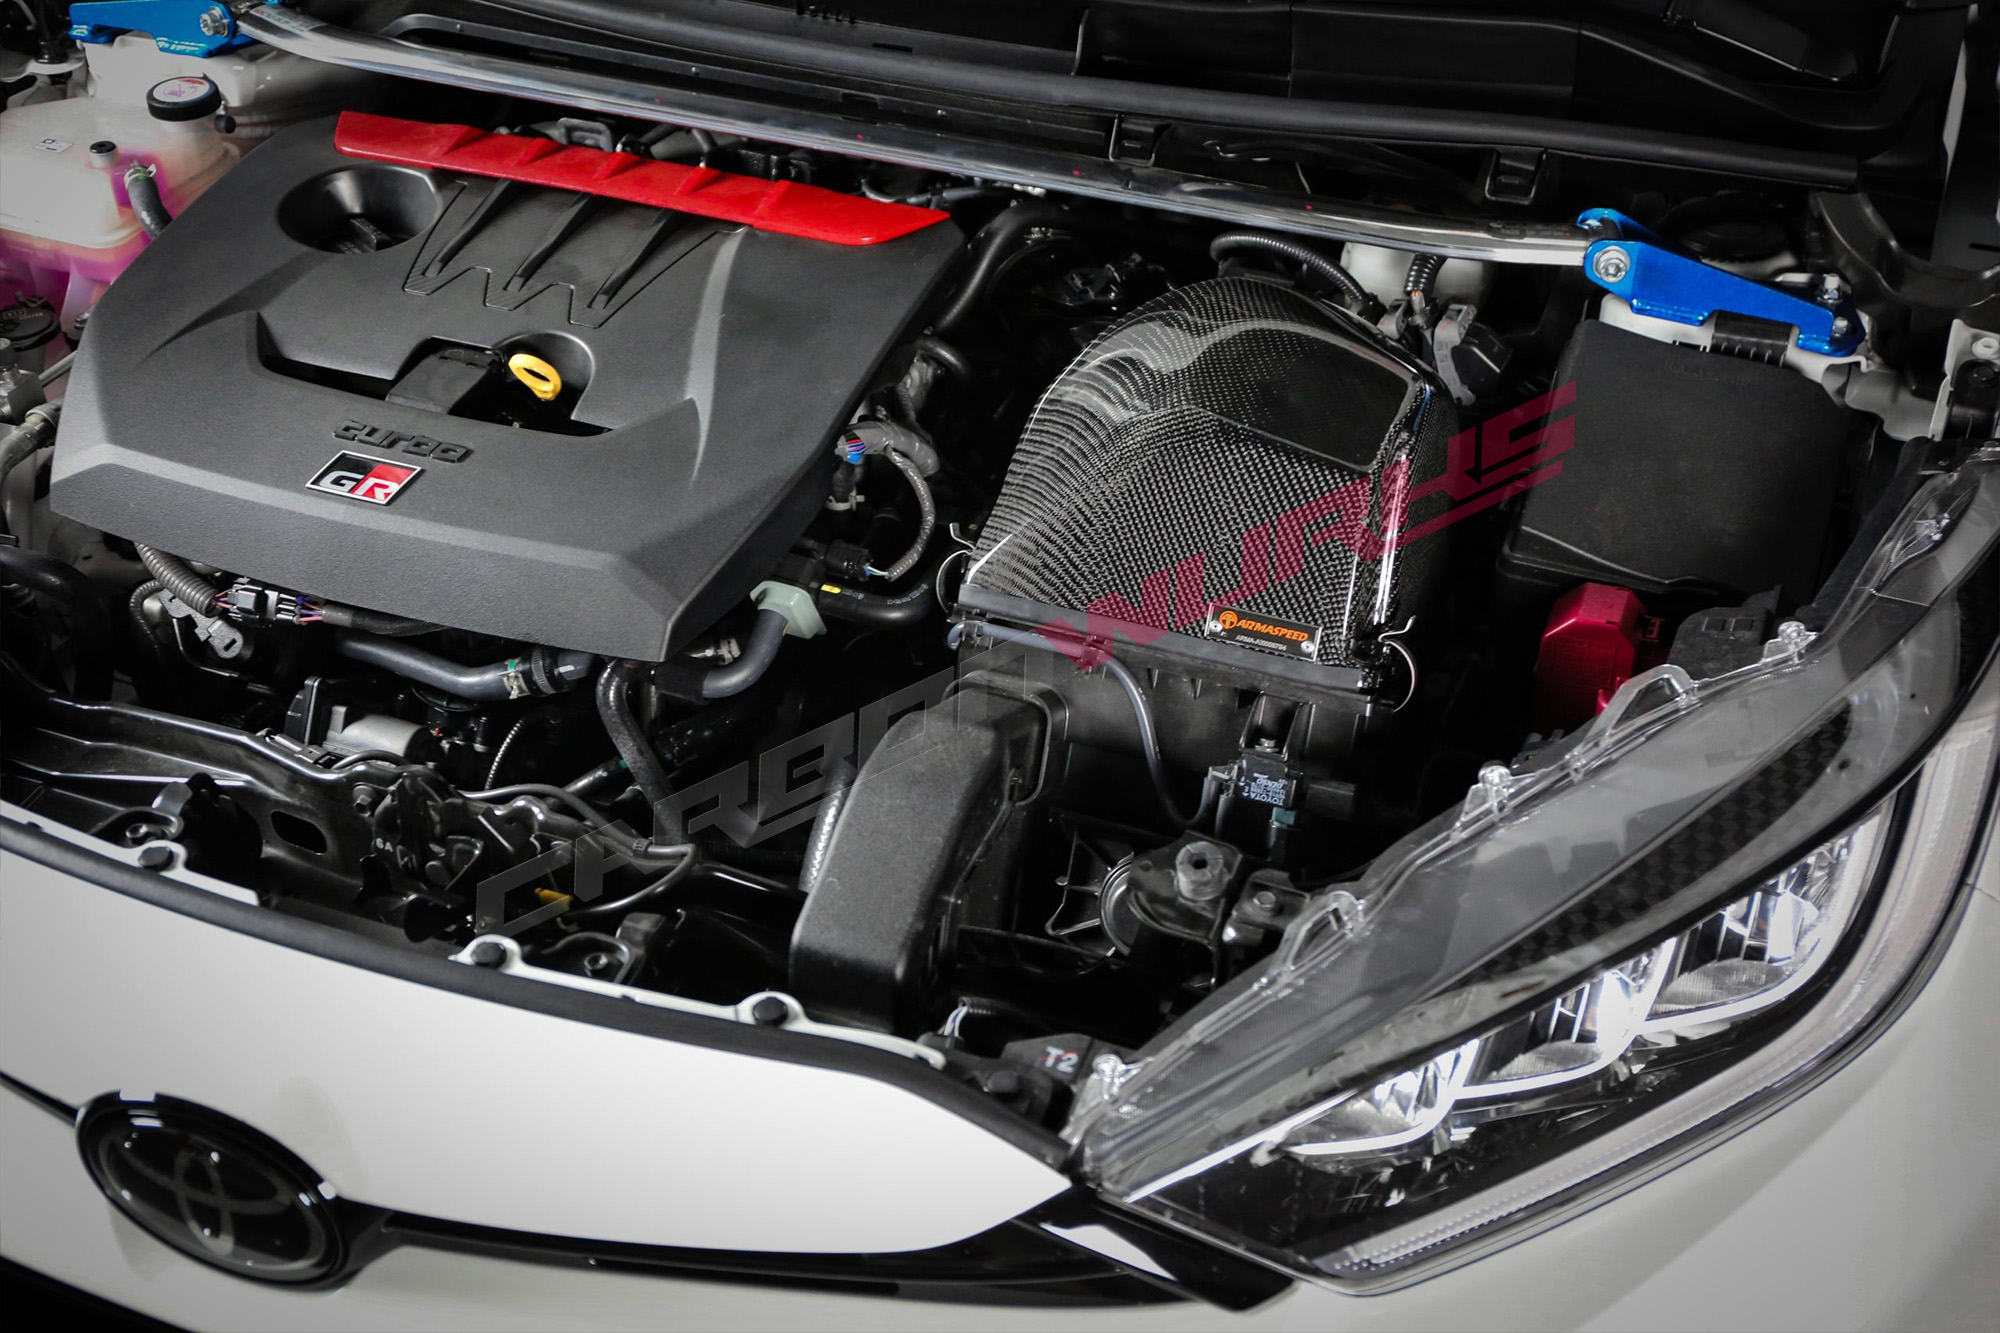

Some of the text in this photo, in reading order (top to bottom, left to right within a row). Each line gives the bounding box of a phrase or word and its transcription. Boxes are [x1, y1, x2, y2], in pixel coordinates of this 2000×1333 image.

[318, 470, 400, 501] GR
[1237, 618, 1309, 642] ARMASPEED
[1249, 791, 1284, 806] TOYOTA
[1045, 1045, 1079, 1074] T2
